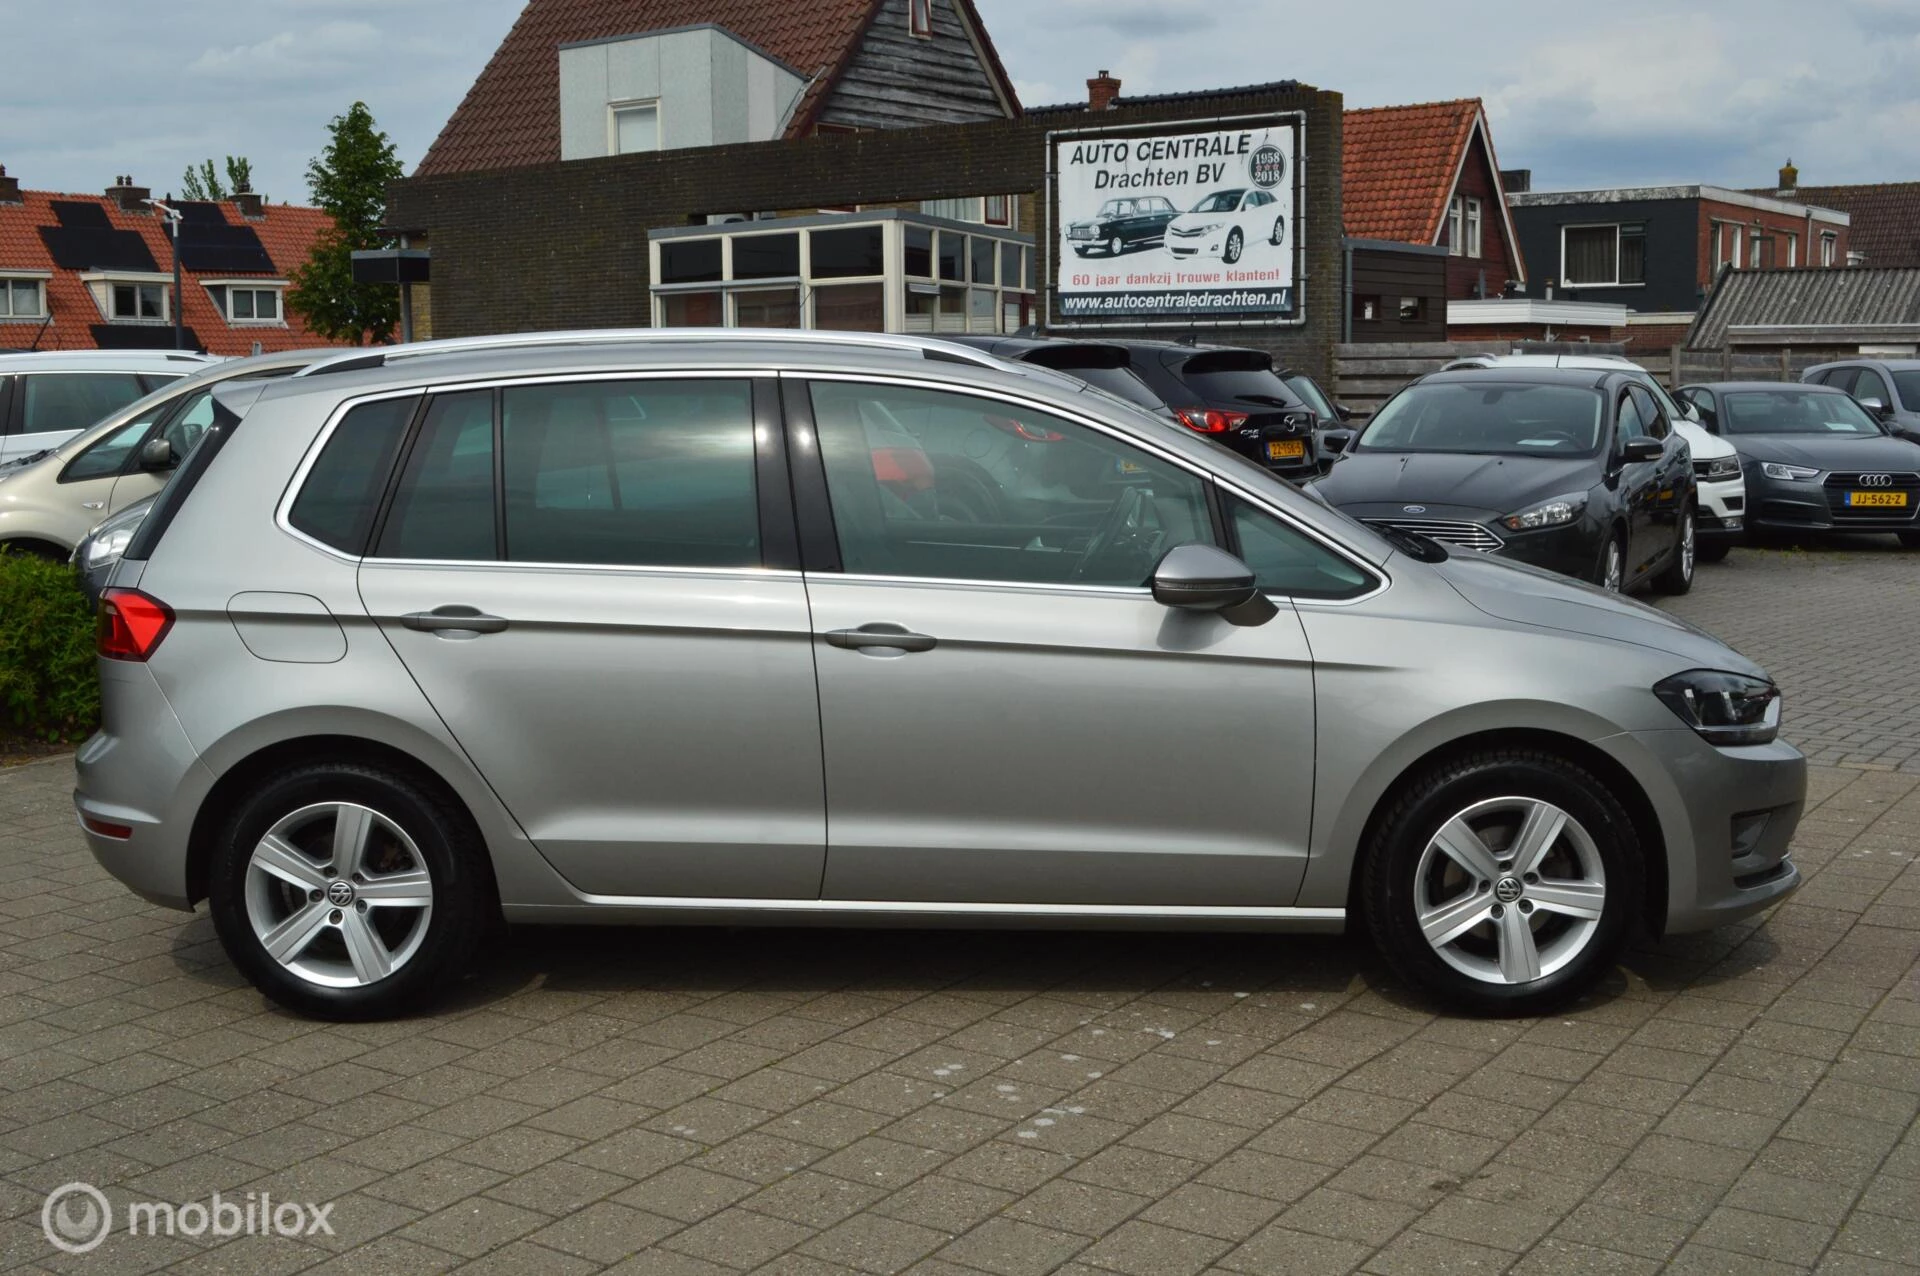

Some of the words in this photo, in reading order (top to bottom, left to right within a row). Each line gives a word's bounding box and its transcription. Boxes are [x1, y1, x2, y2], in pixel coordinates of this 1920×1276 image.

[1070, 142, 1129, 165] AUTO
[1136, 134, 1252, 161] CENTRALE
[1255, 151, 1280, 165] 1958
[1094, 167, 1189, 189] Drachten
[1196, 162, 1226, 184] BV
[1255, 170, 1280, 183] 2018
[1072, 274, 1090, 286] 60
[1095, 274, 1120, 287] jaar
[1126, 272, 1171, 286] dankzij
[1176, 272, 1220, 283] trouwe
[1226, 269, 1280, 282] klanten!
[1064, 289, 1287, 309] www.autocentraledrachten.nl
[1855, 494, 1901, 505] JJ-562-Z
